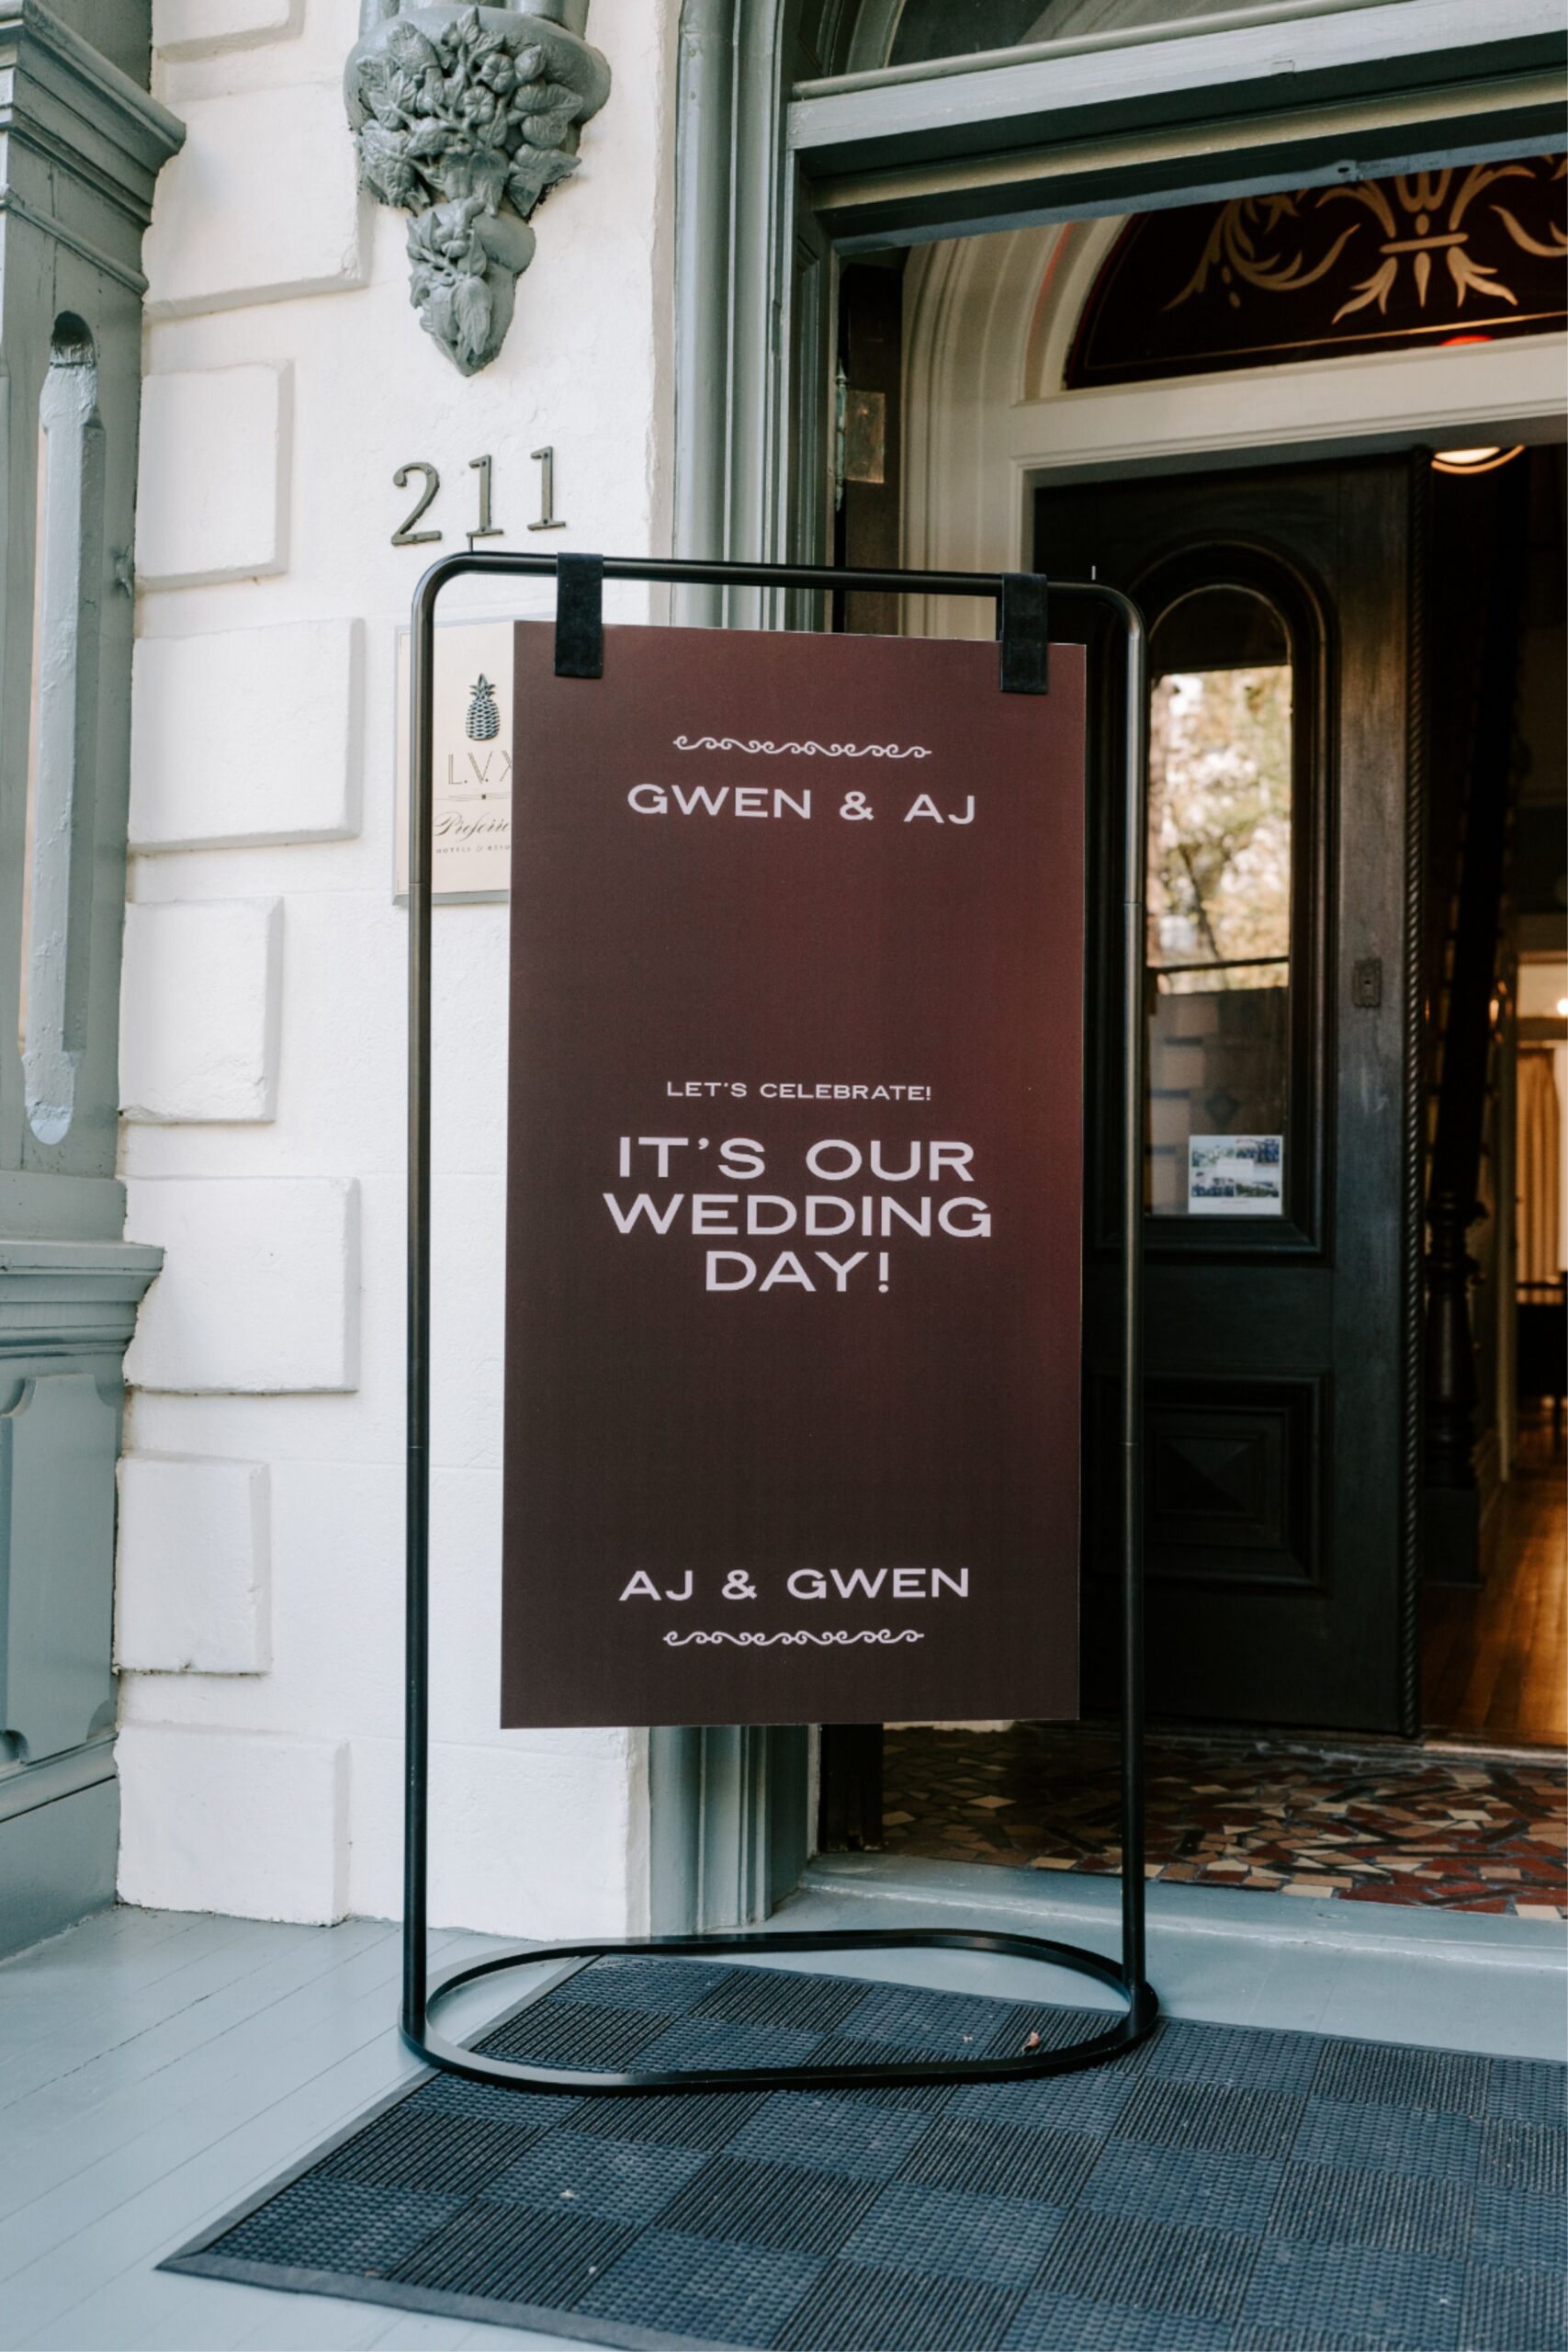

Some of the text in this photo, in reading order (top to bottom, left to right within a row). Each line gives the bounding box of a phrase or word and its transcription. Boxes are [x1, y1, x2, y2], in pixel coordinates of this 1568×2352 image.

[391, 446, 566, 547] 211
[627, 783, 975, 825] GWEN & AJ
[434, 811, 511, 842] Preferre
[667, 1081, 931, 1101] LET'S CELEBRATE!
[619, 1136, 975, 1182] IT'S OUR
[603, 1193, 991, 1238] WEDDING
[705, 1250, 889, 1294] DAY!
[619, 1567, 969, 1601] AJ & GWEN
